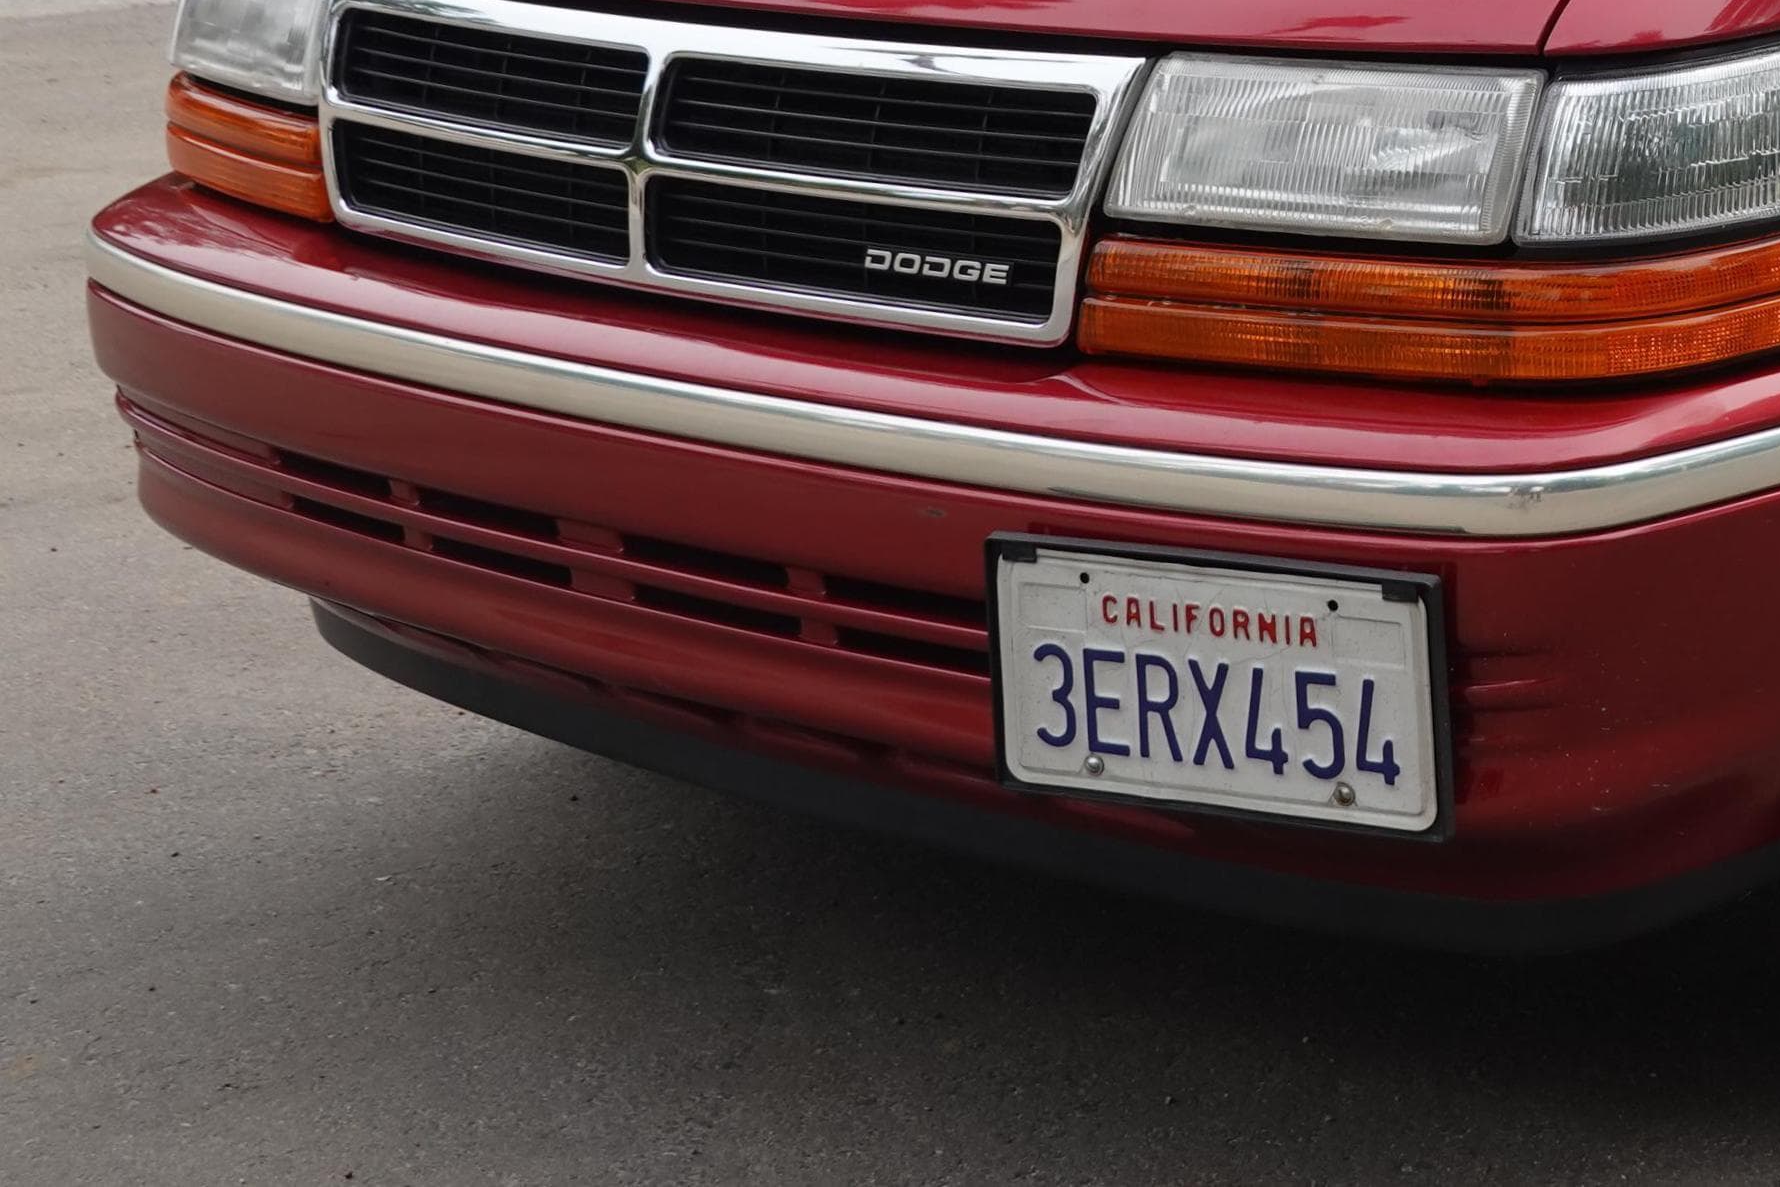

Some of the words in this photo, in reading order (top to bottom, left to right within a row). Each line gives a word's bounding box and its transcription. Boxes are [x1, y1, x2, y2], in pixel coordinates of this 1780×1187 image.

[864, 248, 1010, 285] DODGE
[1102, 594, 1319, 648] CALIFORNIA
[1033, 643, 1401, 786] 3ERX454
